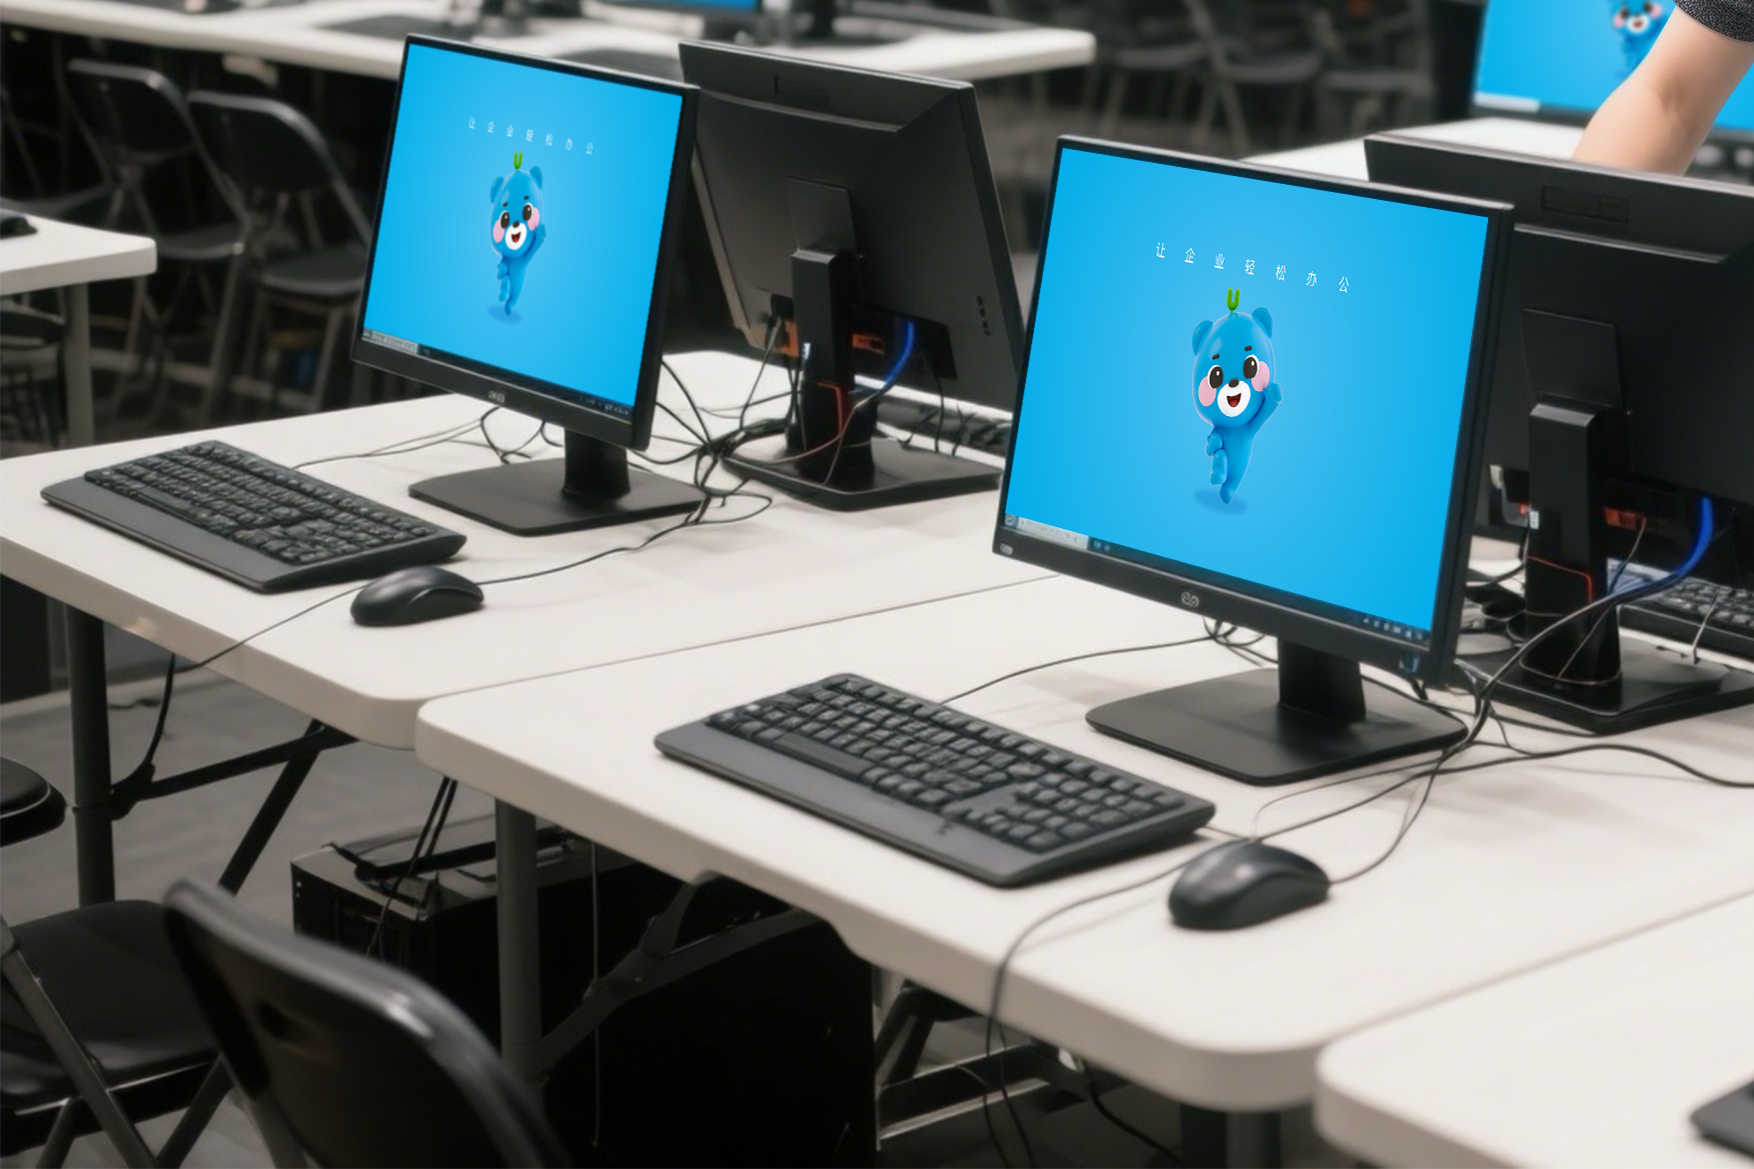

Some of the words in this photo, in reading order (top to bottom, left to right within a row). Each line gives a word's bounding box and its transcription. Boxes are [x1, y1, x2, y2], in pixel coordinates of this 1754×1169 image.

[468, 116, 594, 156] 让企业轻松办公
[1155, 241, 1350, 294] 让企业轻松办公
